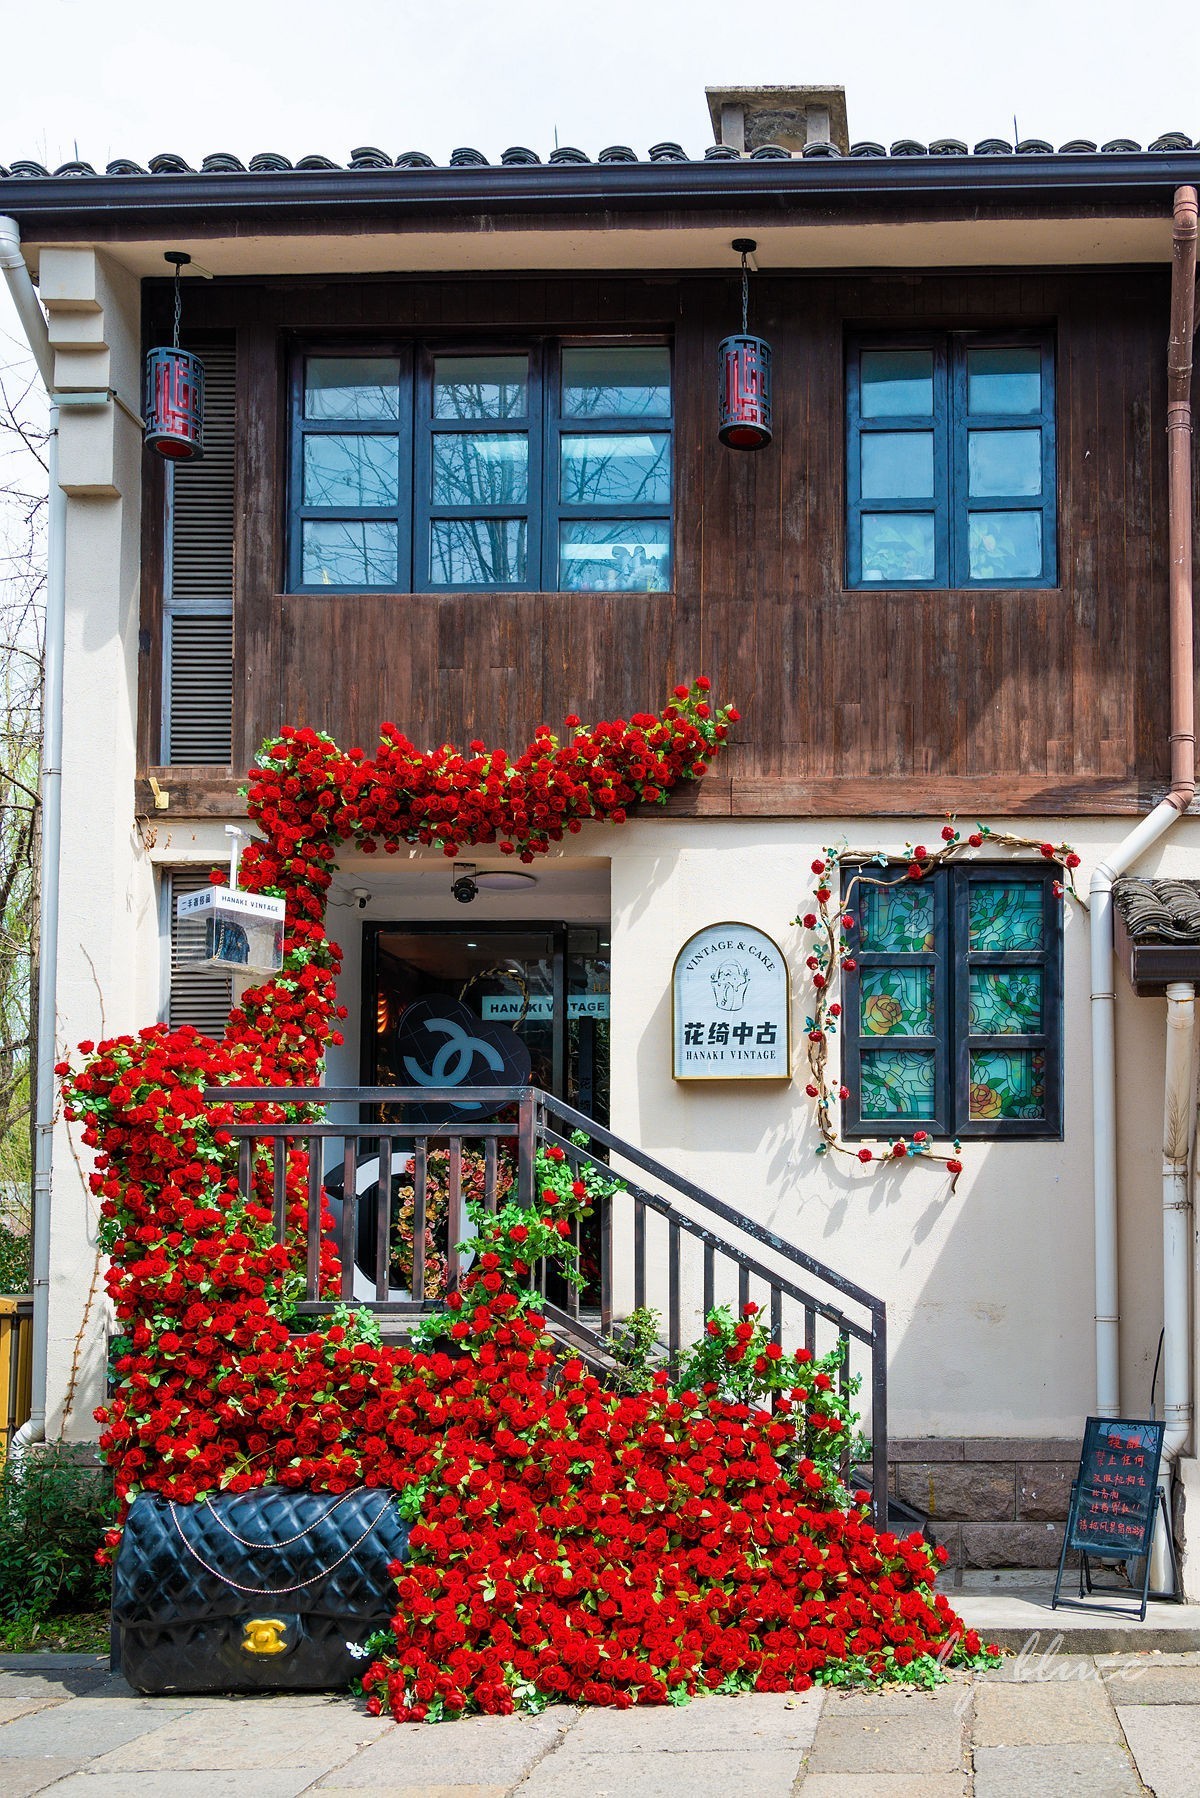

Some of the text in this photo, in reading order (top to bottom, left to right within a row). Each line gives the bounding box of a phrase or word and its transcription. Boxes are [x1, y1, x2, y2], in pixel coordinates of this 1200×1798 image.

[221, 895, 279, 913] HANAKI VINTAGE
[686, 941, 776, 972] VINTAGE & CAKE
[490, 1003, 542, 1013] HANAKI
[684, 1021, 778, 1046] 花绮中古
[686, 1050, 777, 1060] HANAKI VINTAGE
[1107, 1434, 1142, 1449] 提醒
